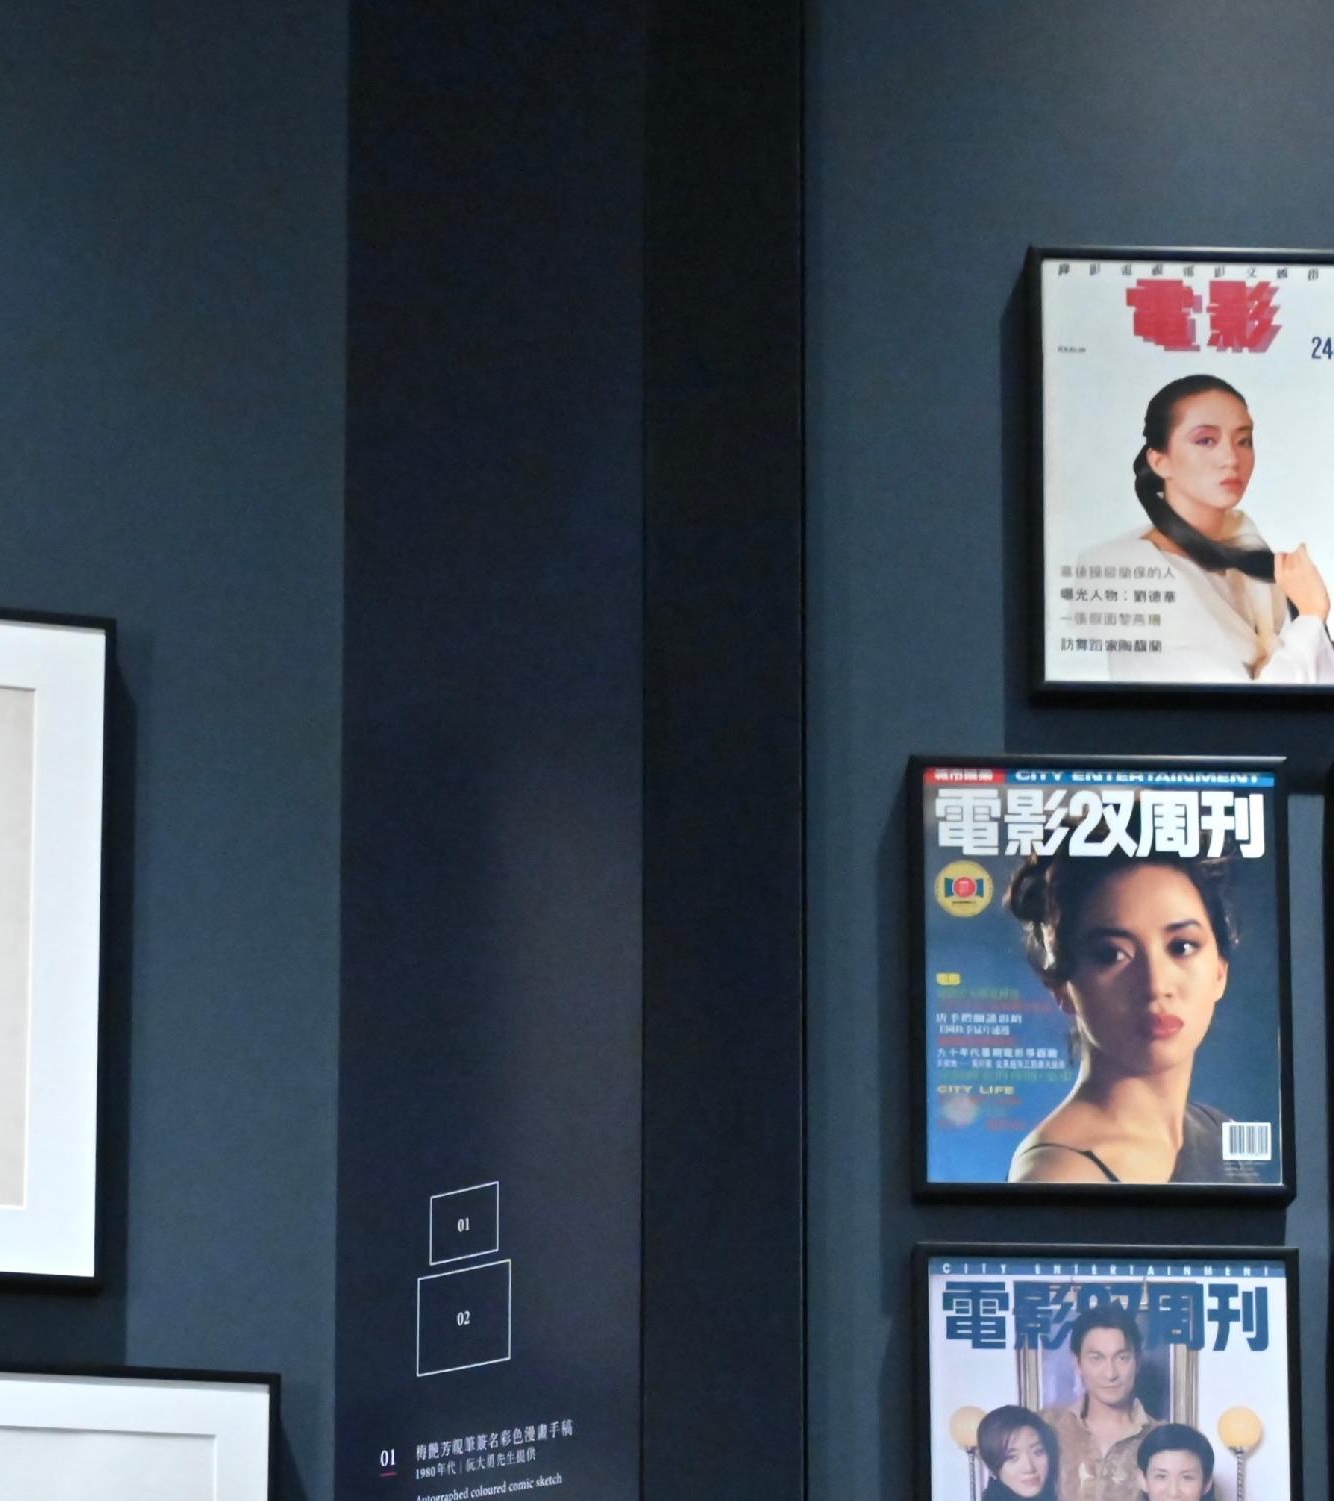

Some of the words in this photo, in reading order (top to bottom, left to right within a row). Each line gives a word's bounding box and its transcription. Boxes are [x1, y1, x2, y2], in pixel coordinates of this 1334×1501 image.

[1016, 771, 1064, 781] CITY
[1073, 771, 1261, 784] ENTERTAINMENT
[937, 1085, 972, 1093] CITY
[979, 1086, 1014, 1094] LIFE
[457, 1218, 470, 1233] 01
[942, 1263, 1009, 1274] CITY
[1035, 1264, 1268, 1277] ENTERTAINMENT
[457, 1311, 471, 1326] 02
[380, 1449, 395, 1466] 01
[471, 1482, 506, 1498] coloured
[509, 1478, 534, 1492] comic
[536, 1473, 562, 1487] sketch
